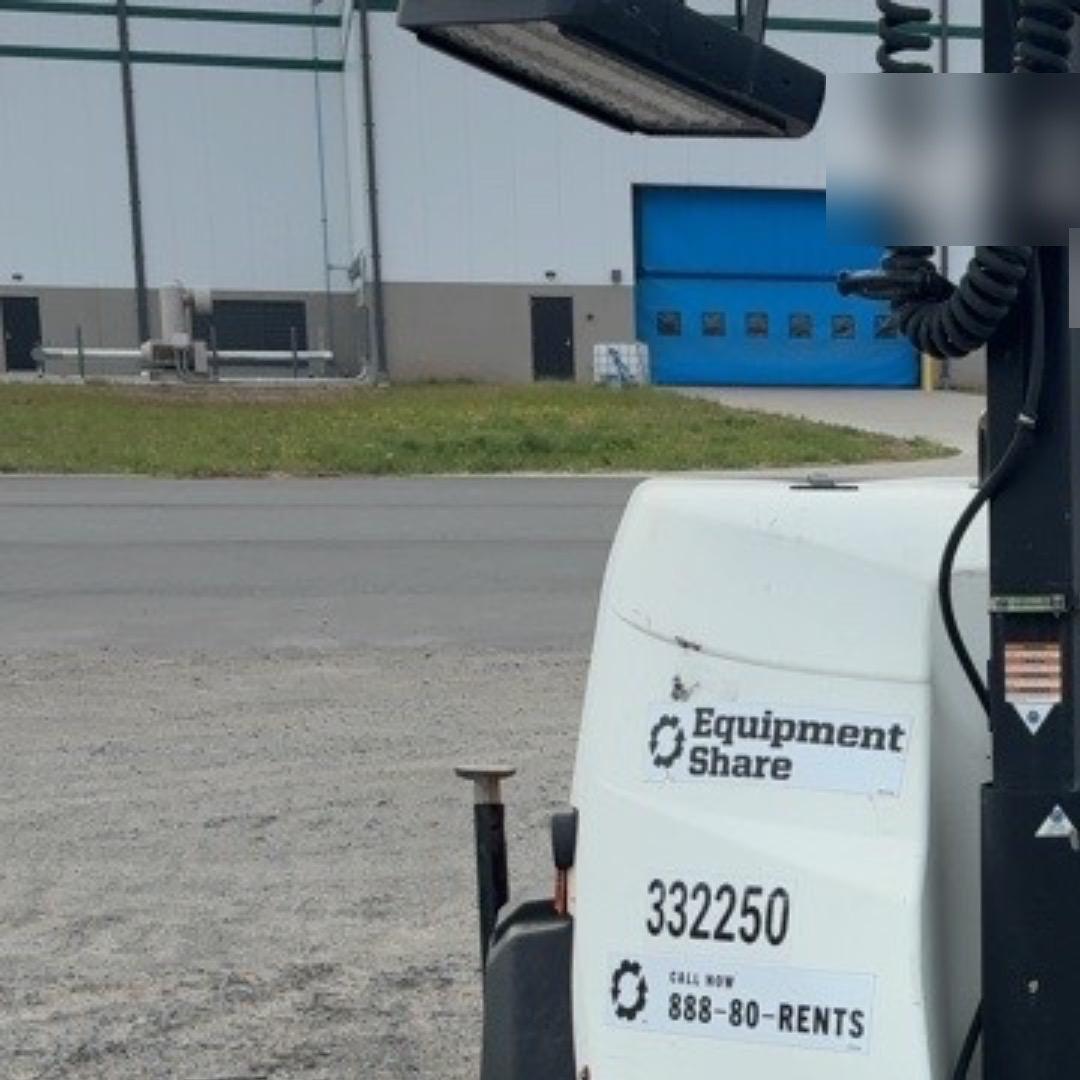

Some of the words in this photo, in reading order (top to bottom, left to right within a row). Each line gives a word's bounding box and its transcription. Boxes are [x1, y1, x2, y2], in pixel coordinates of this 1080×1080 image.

[692, 707, 906, 752] Equipment
[689, 746, 793, 780] Share
[646, 878, 790, 946] 332250
[669, 971, 700, 987] CALL
[705, 974, 735, 989] NOW
[668, 992, 865, 1039] 888-80-RENTS
